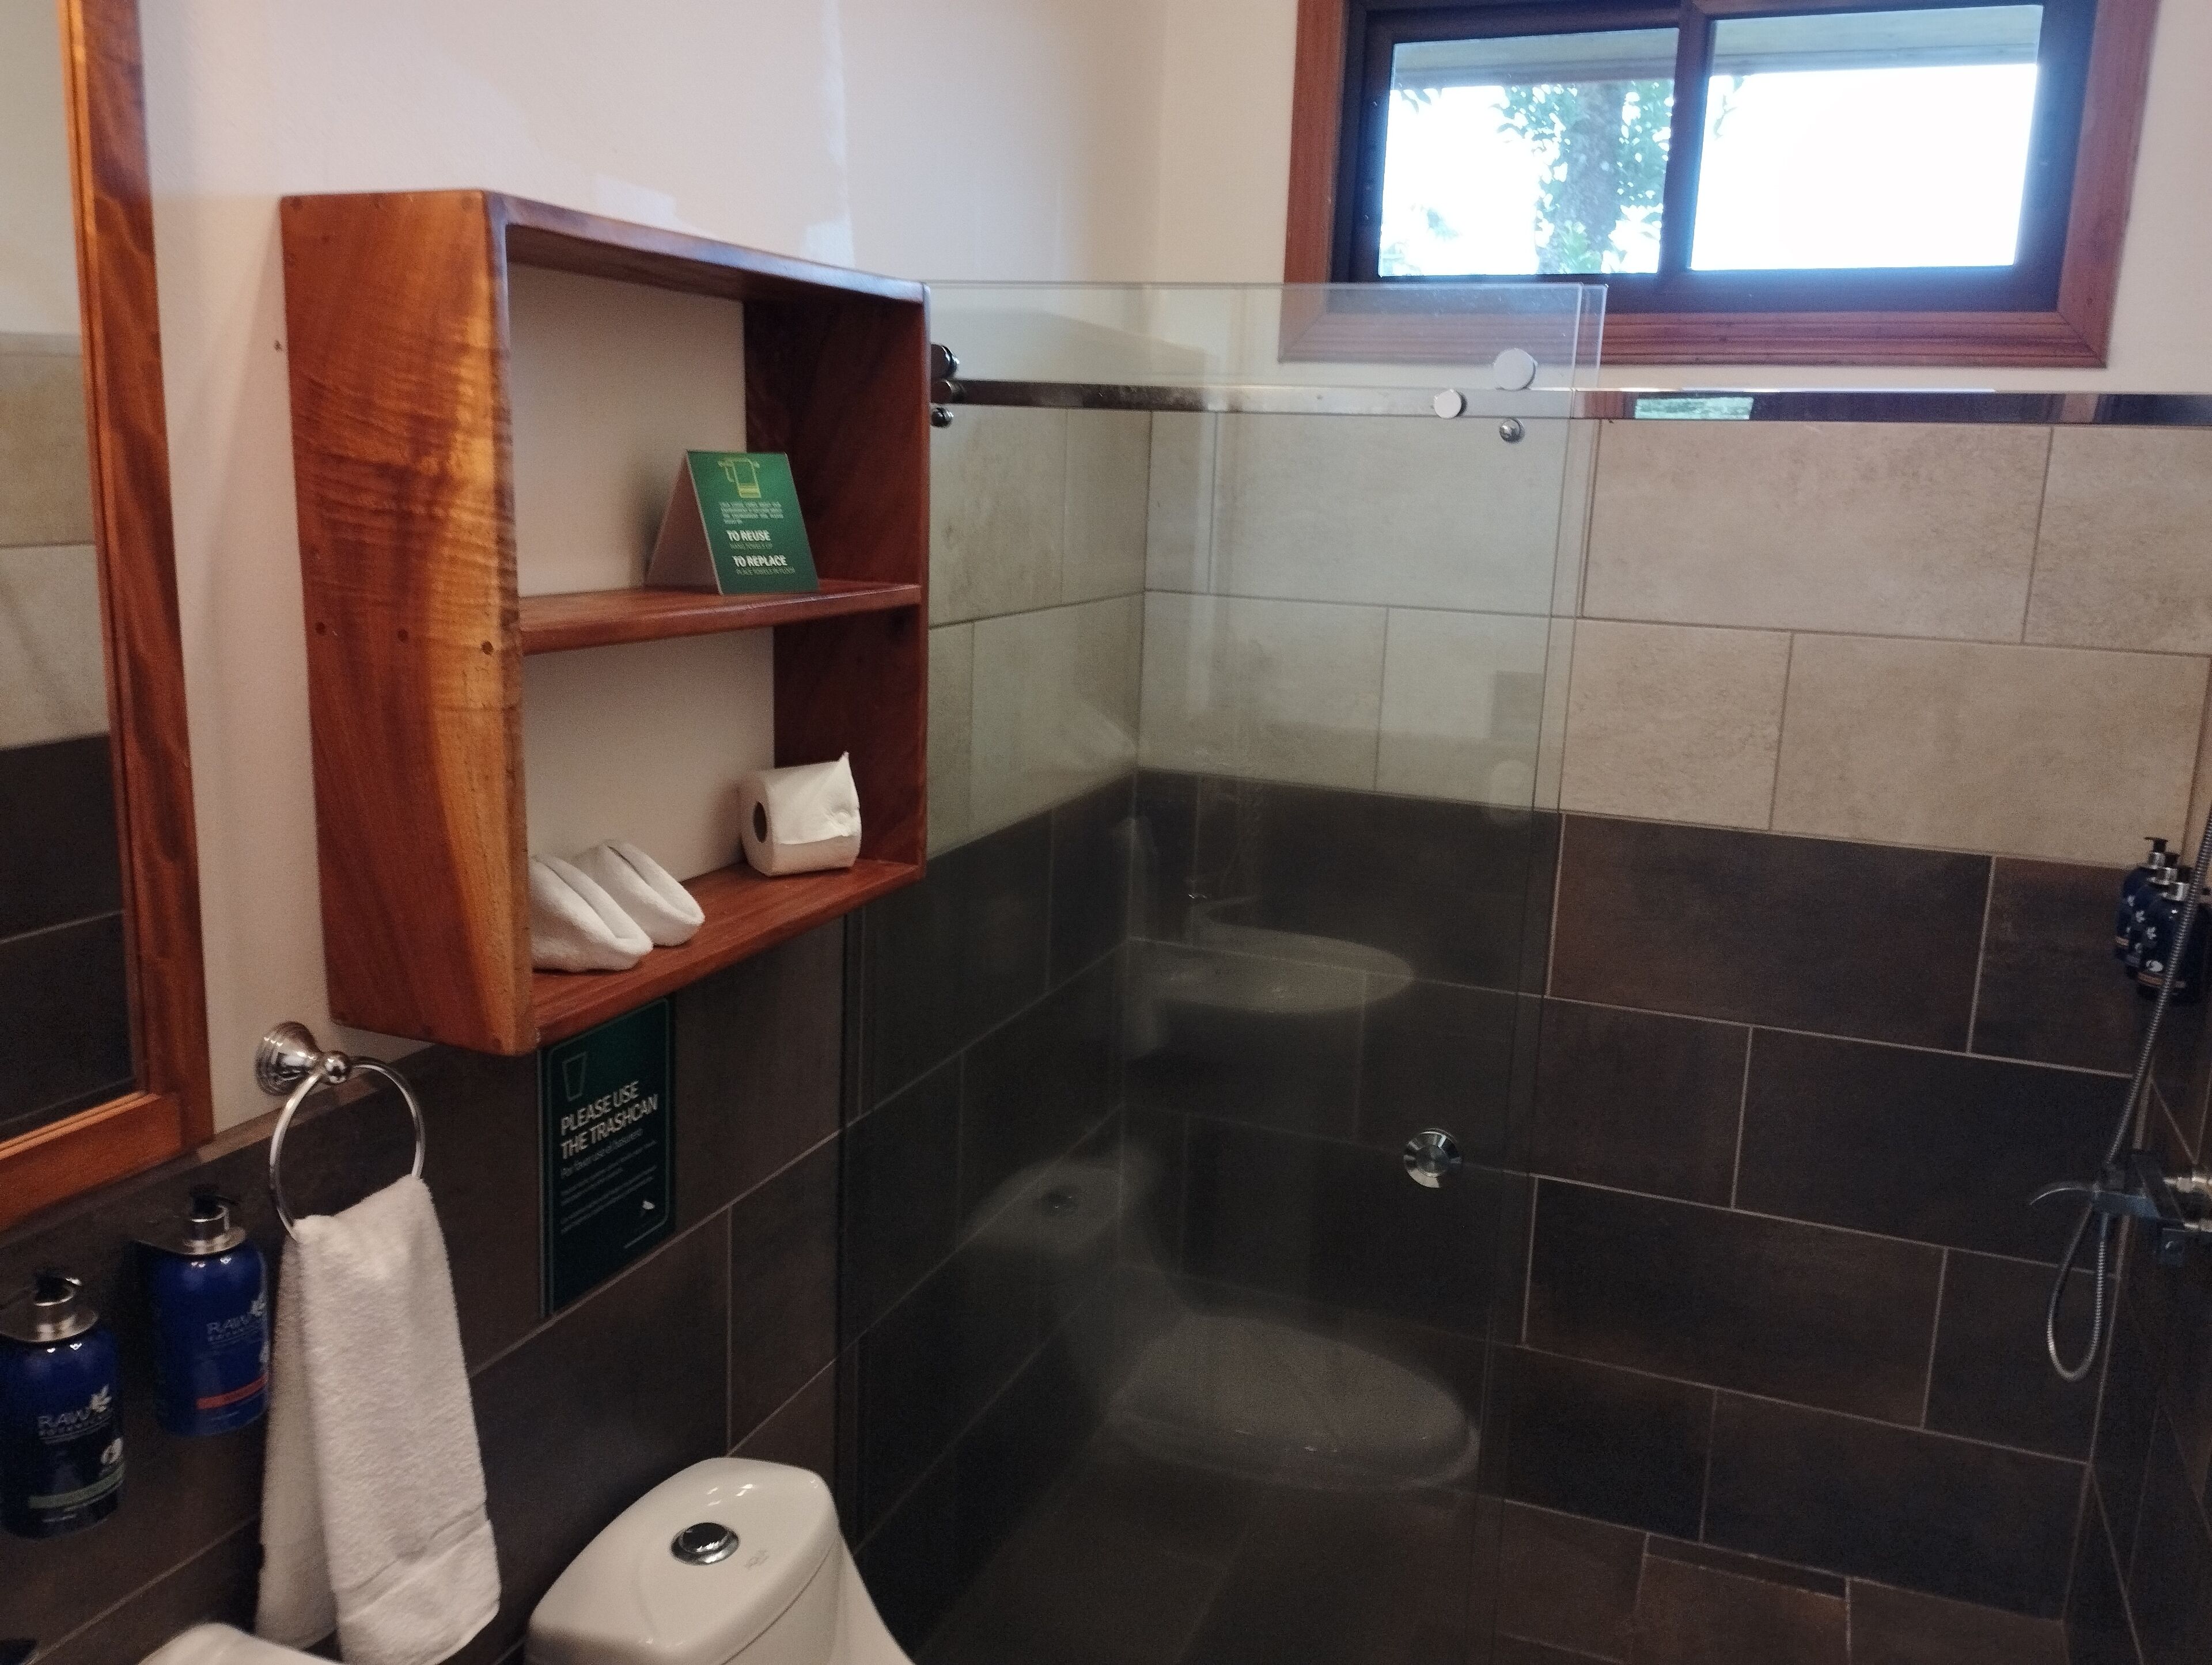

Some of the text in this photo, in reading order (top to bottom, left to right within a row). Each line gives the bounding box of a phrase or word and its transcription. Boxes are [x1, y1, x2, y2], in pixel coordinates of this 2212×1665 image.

[726, 530, 771, 541] TO REUSE
[732, 555, 787, 567] TO REPLACE
[560, 1080, 640, 1136] PLEASE USE
[560, 1093, 658, 1159] THE TRASHCAN
